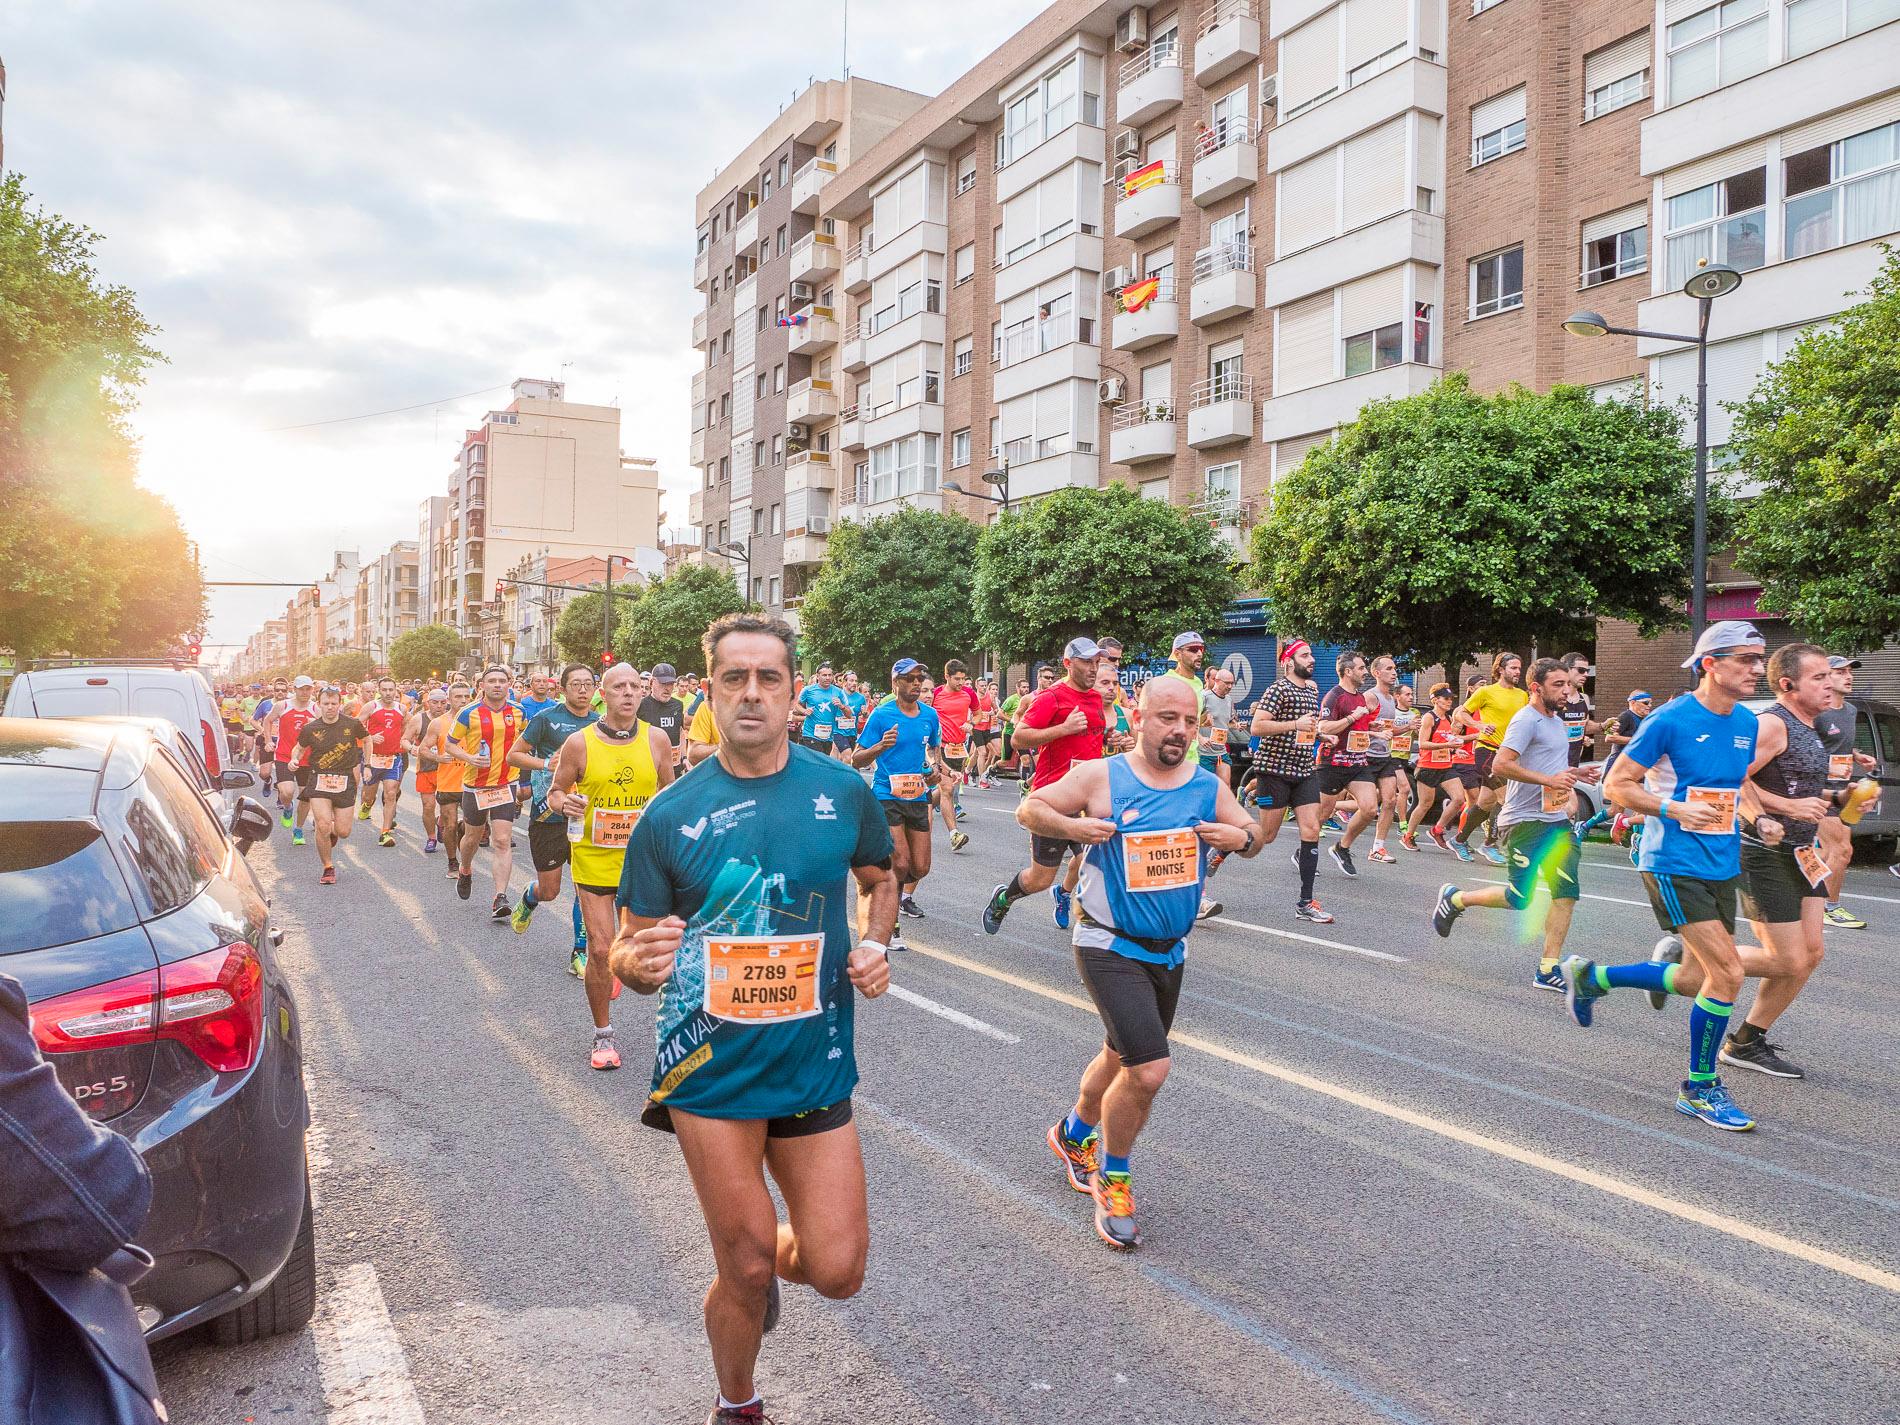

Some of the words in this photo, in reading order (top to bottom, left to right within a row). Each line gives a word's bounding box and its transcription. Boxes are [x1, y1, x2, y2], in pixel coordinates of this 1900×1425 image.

[660, 716, 675, 727] EDU
[593, 797, 604, 808] CC
[608, 797, 620, 807] LA
[624, 795, 649, 807] LLUM
[610, 822, 630, 830] 2844
[602, 832, 612, 840] jm
[613, 833, 631, 841] gom
[1148, 848, 1182, 861] 10613
[1146, 862, 1185, 877] MONTSE
[743, 964, 787, 980] 2789
[731, 985, 797, 1004] ALFONSO
[658, 1034, 688, 1076] 21K
[75, 1082, 106, 1100] DS
[109, 1075, 128, 1092] 5
